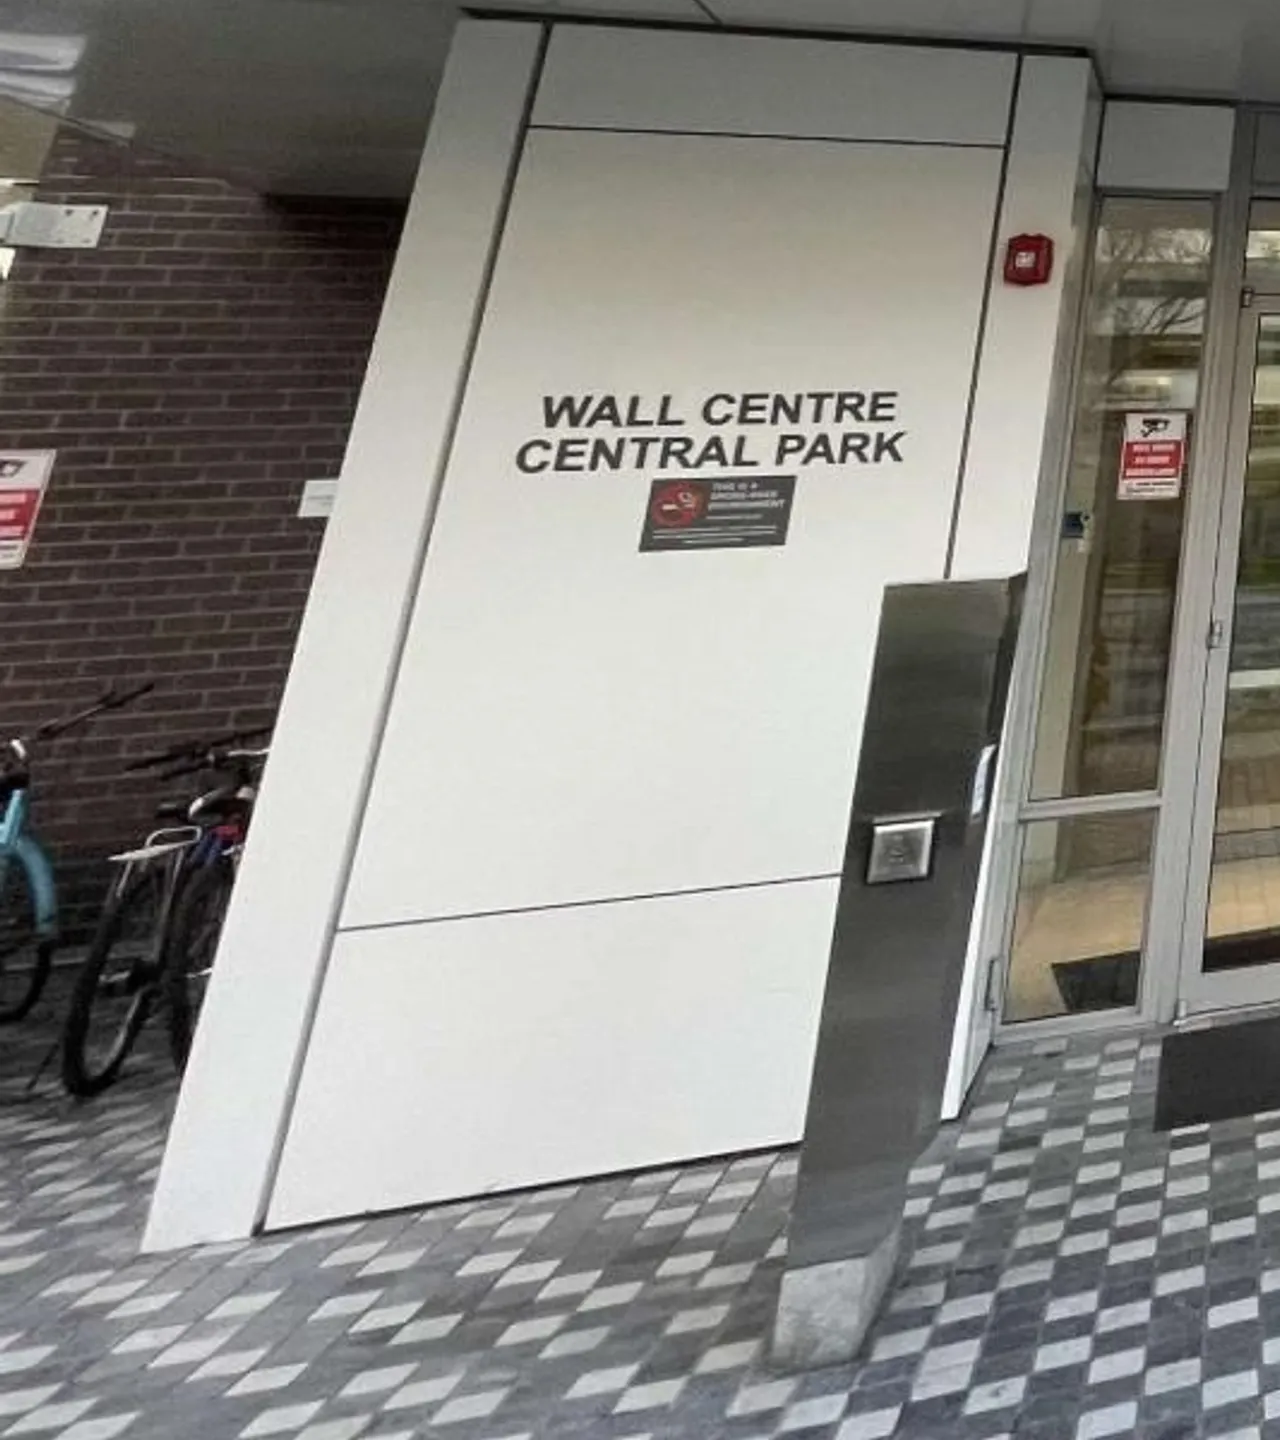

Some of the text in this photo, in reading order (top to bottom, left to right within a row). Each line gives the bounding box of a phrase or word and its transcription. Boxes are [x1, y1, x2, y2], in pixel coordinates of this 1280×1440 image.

[542, 391, 898, 428] WALL CENTRE
[515, 430, 906, 474] CENTRAL PARK
